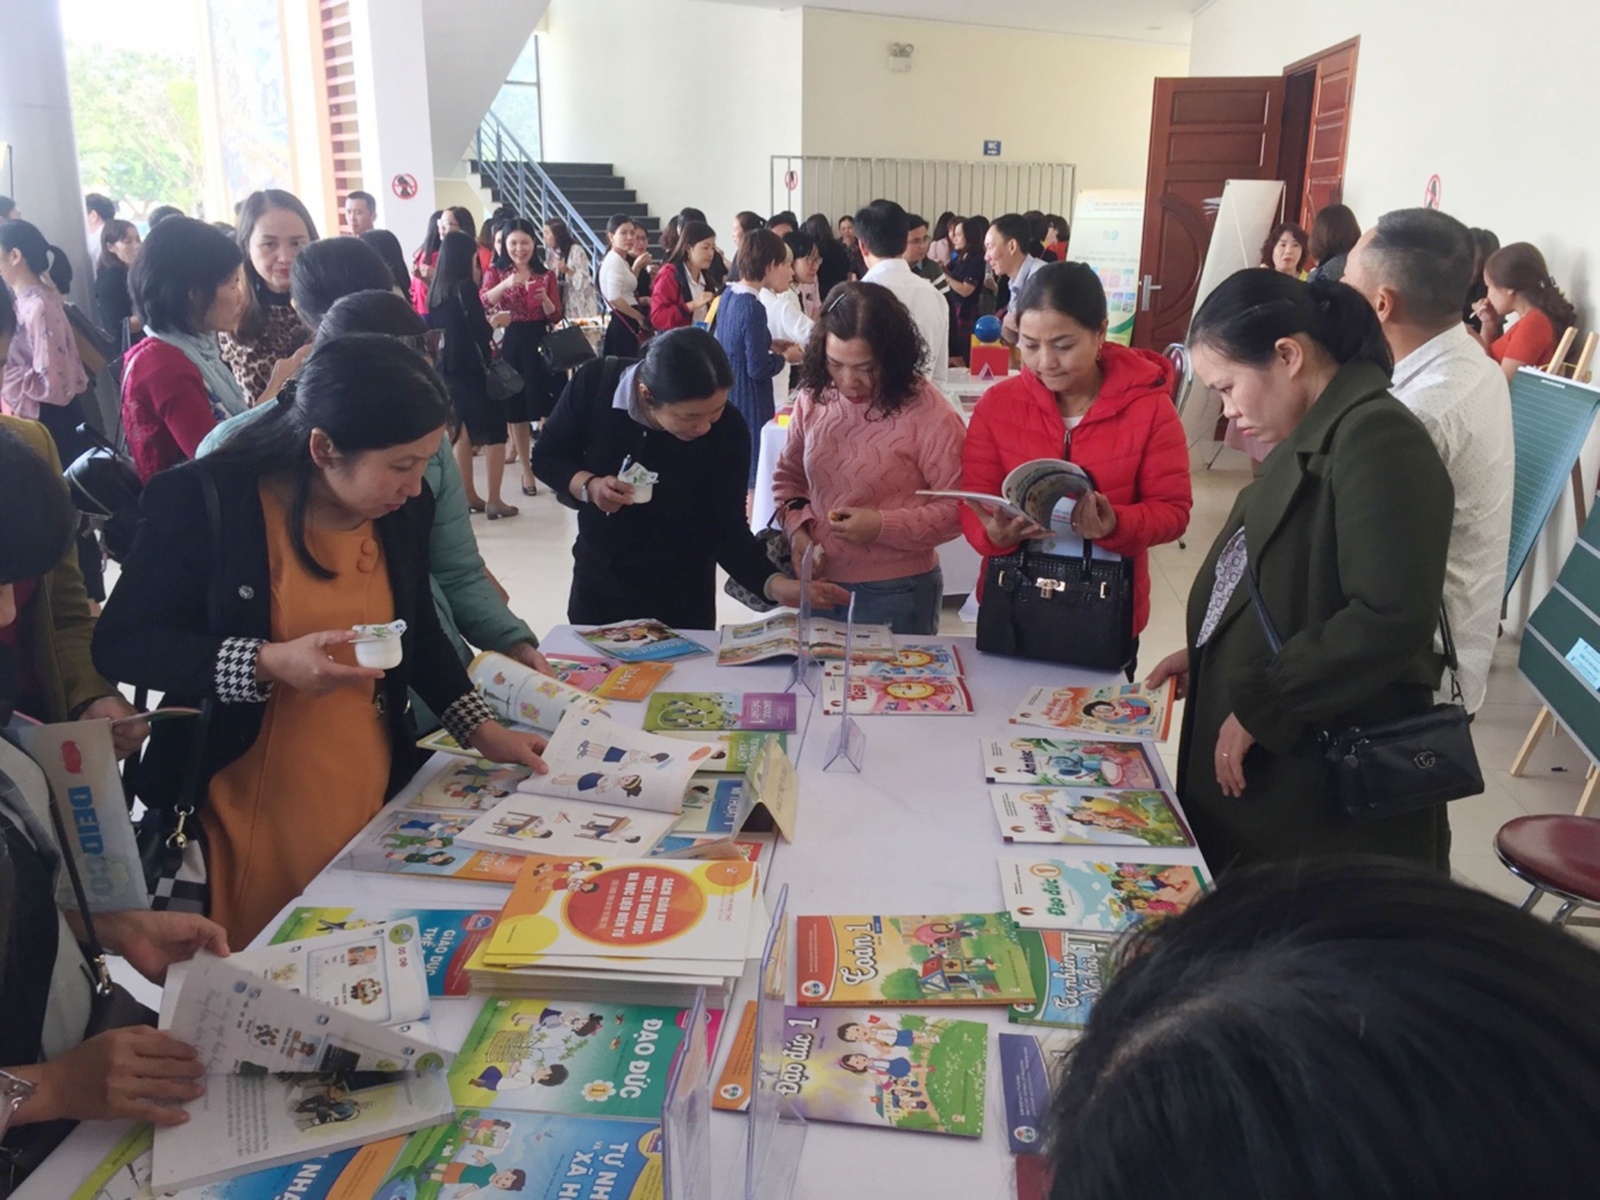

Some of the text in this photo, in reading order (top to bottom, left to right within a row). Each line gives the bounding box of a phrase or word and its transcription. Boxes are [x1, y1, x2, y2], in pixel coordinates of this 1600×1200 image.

[655, 896, 671, 913] GIÁO
[1041, 878, 1061, 896] đức
[635, 903, 651, 919] GIÁO
[1046, 897, 1068, 917] Đạo
[434, 929, 457, 954] GIÁO
[840, 921, 879, 986] Toán 1
[1069, 943, 1098, 953] 1
[1051, 953, 1078, 988] nhiên
[632, 1019, 664, 1056] ĐẠO
[774, 1017, 819, 1096] Đạo đức 1
[619, 1060, 652, 1099] ĐỨC
[274, 1164, 323, 1200] NHẠ
[561, 1151, 595, 1200] XÃ H
[589, 1142, 630, 1200] TỰ NH
